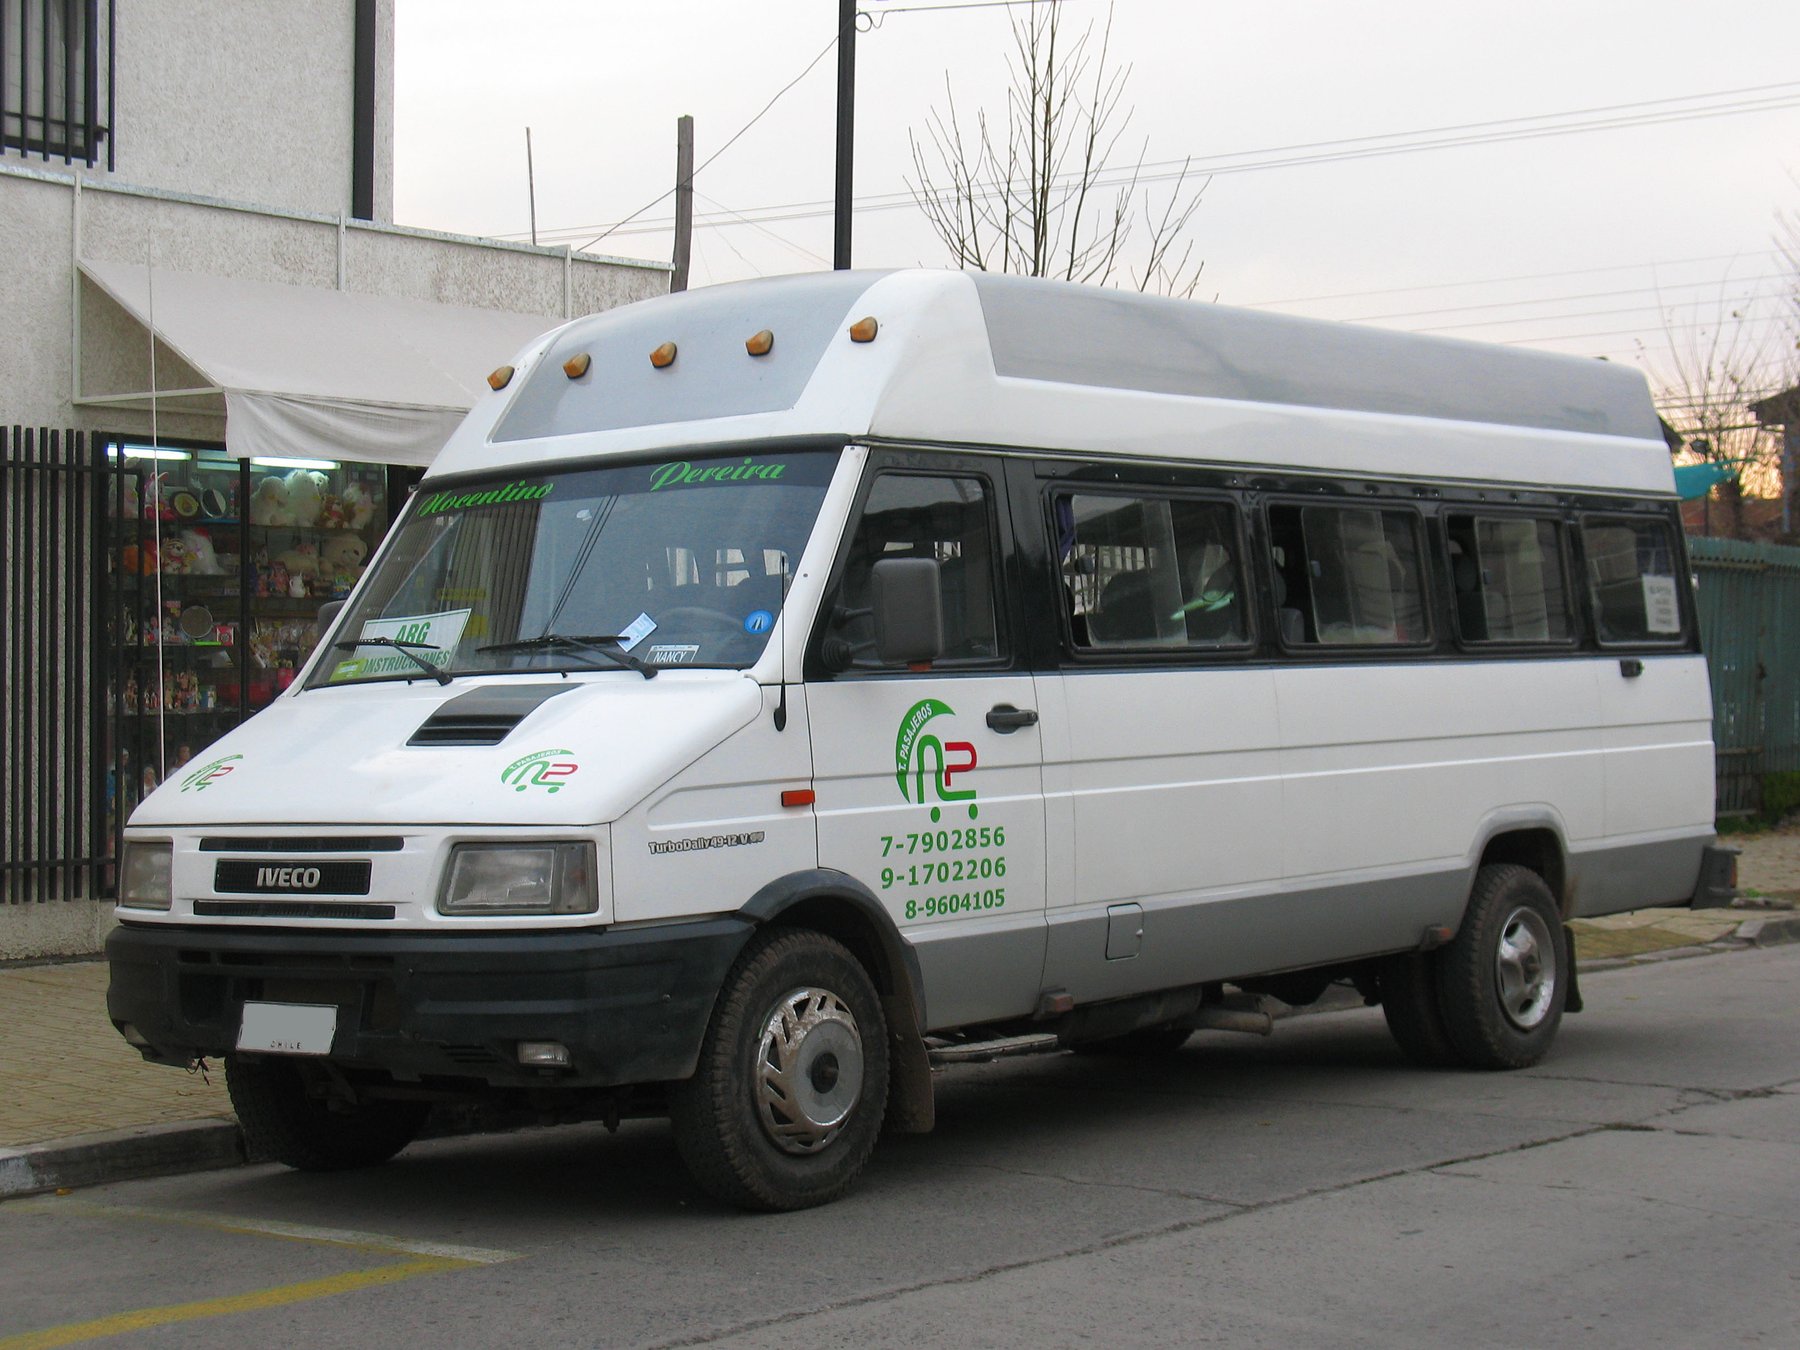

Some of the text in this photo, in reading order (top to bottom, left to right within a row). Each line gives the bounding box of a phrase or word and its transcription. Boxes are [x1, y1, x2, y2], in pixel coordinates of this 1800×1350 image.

[649, 457, 786, 492] Pereira
[395, 621, 431, 645] ARG
[652, 651, 687, 663] NANCY
[900, 703, 933, 760] PASAJEROS
[880, 826, 1006, 857] 7-7902856
[256, 867, 321, 888] IVECO
[880, 856, 1006, 889] 9-1702206
[905, 888, 1006, 919] 8-9604105
[270, 1040, 301, 1050] CHILE
